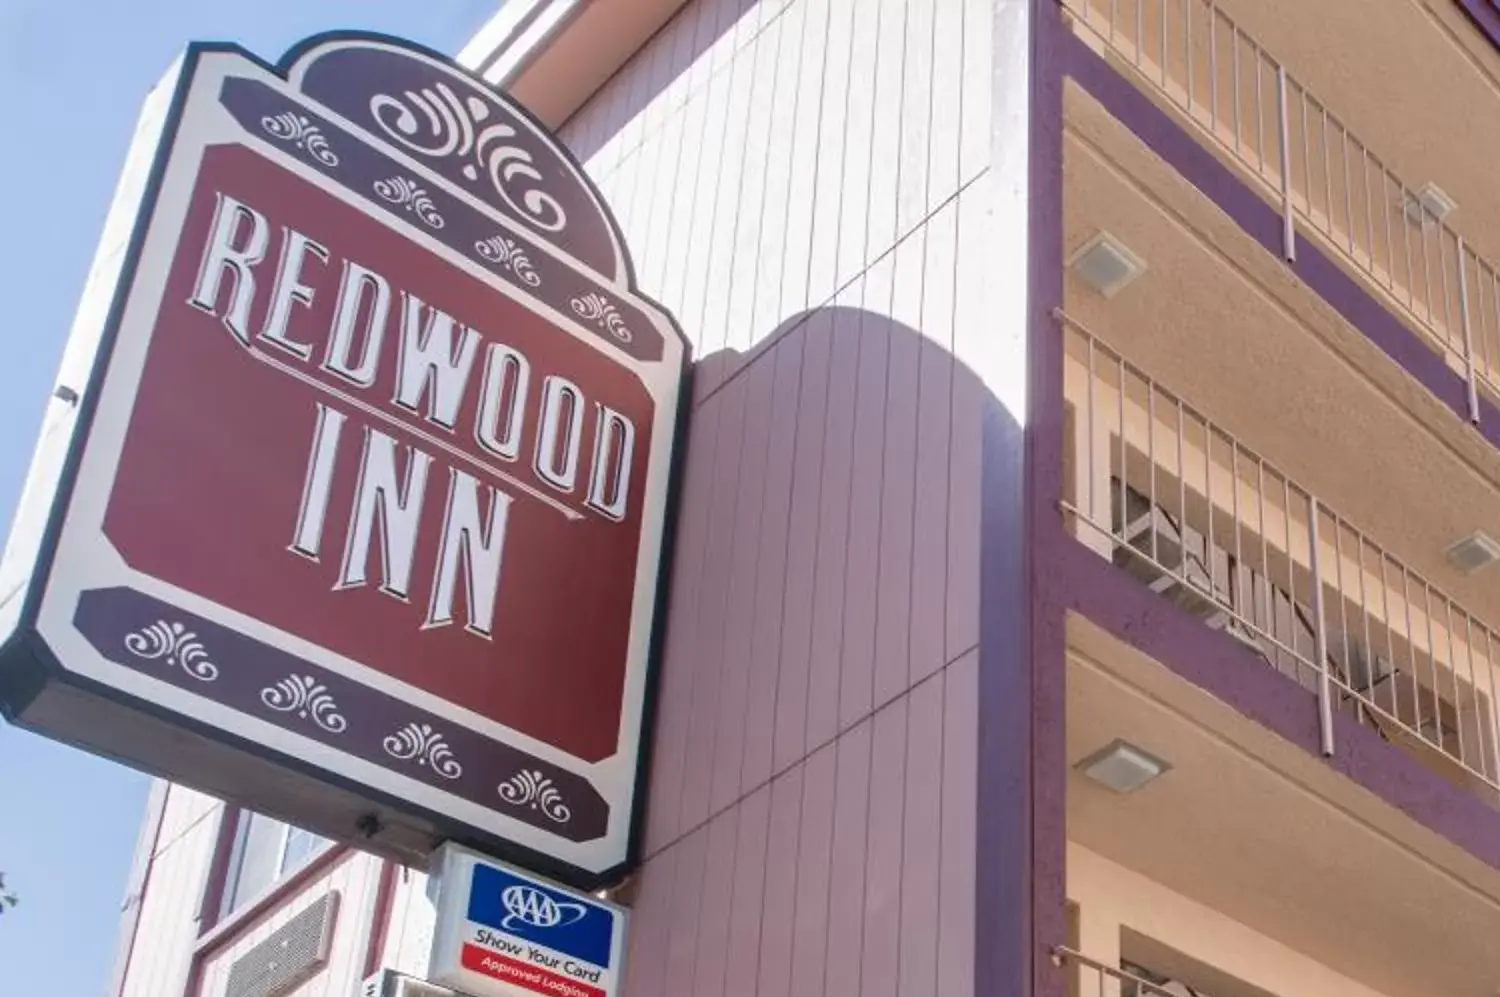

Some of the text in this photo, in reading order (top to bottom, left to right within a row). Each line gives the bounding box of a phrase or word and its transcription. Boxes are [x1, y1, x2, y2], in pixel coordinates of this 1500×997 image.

[186, 192, 635, 522] REDWOOD
[286, 401, 516, 641] INN
[503, 885, 560, 927] AAA
[474, 929, 600, 983] Show Your Card
[481, 956, 542, 983] Approved
